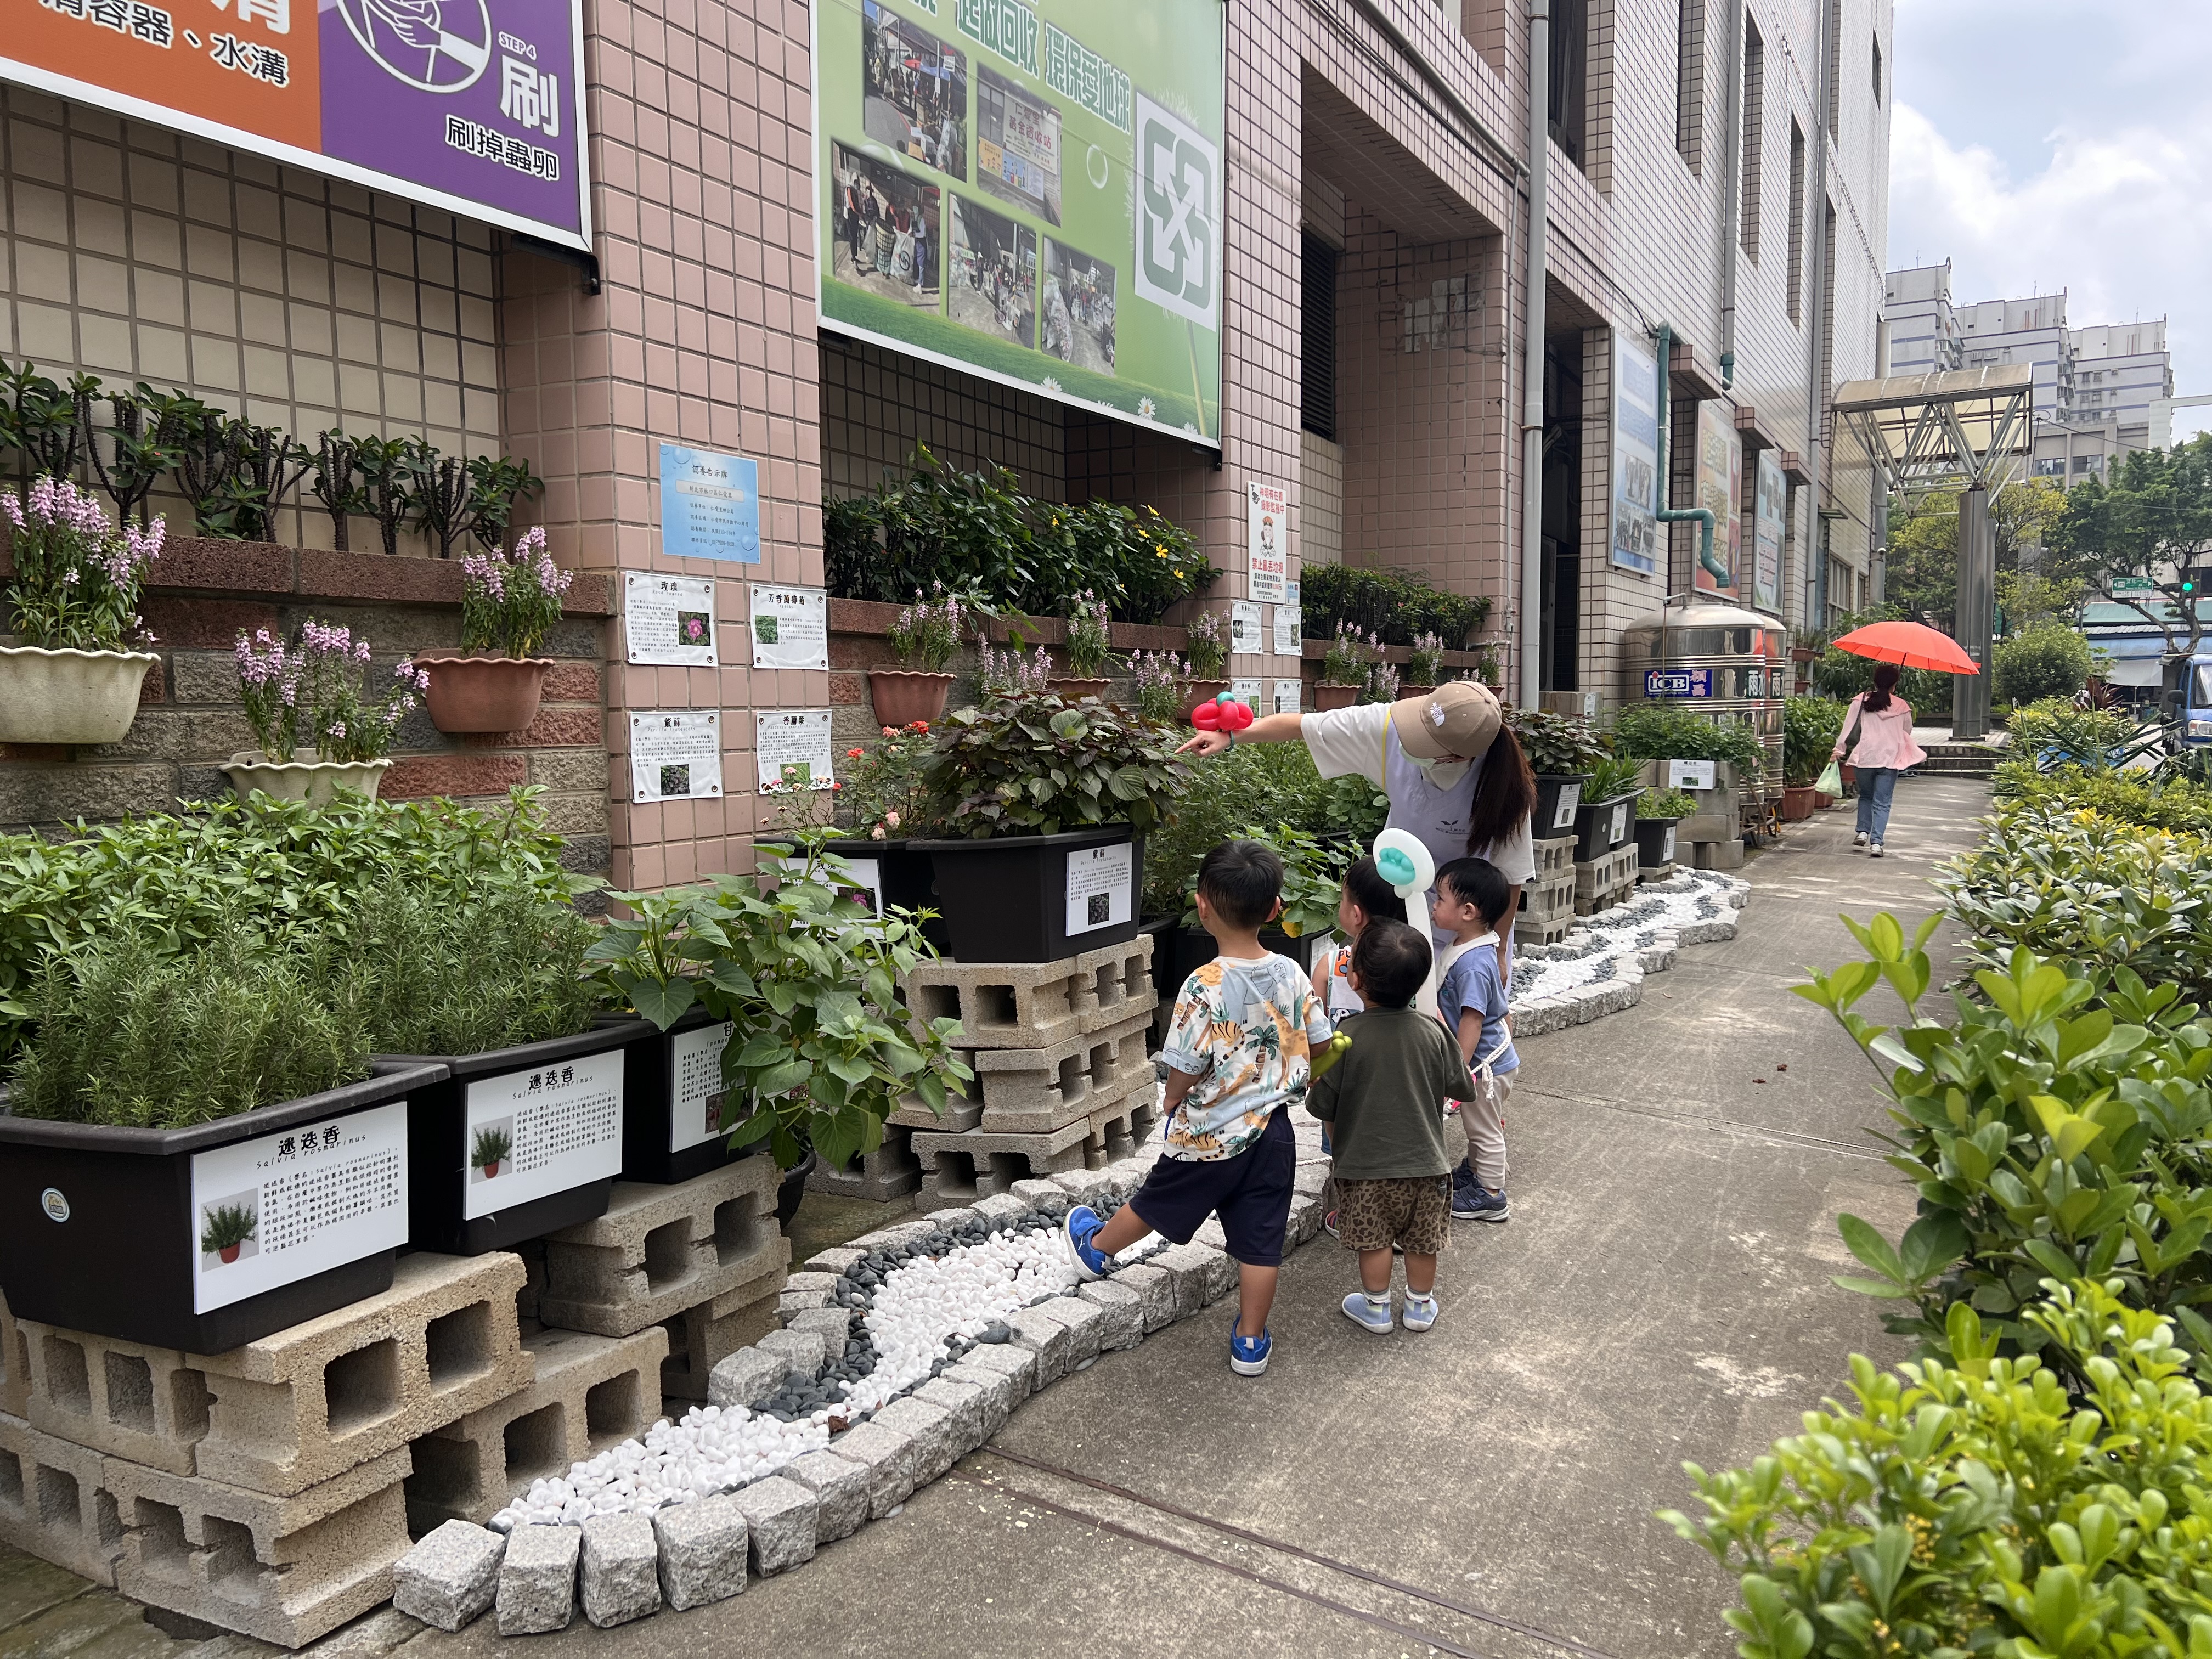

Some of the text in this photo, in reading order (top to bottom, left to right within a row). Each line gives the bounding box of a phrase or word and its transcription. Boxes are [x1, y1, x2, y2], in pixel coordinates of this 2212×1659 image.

[499, 32, 536, 60] STEP 4
[500, 55, 558, 137] 刷
[446, 115, 559, 180] 刷掉蟲卵
[692, 465, 728, 479] 認養告示牌
[1252, 558, 1283, 573] 禁止亂丟垃圾
[661, 581, 678, 591] 玫瑰
[664, 717, 680, 727] 紫蘇
[514, 1076, 593, 1099] Salvia rosmarinus
[529, 1066, 574, 1091] 迷迭香
[257, 1135, 366, 1170] Salvia rosmarinus
[278, 1125, 340, 1156] 迷迭香
